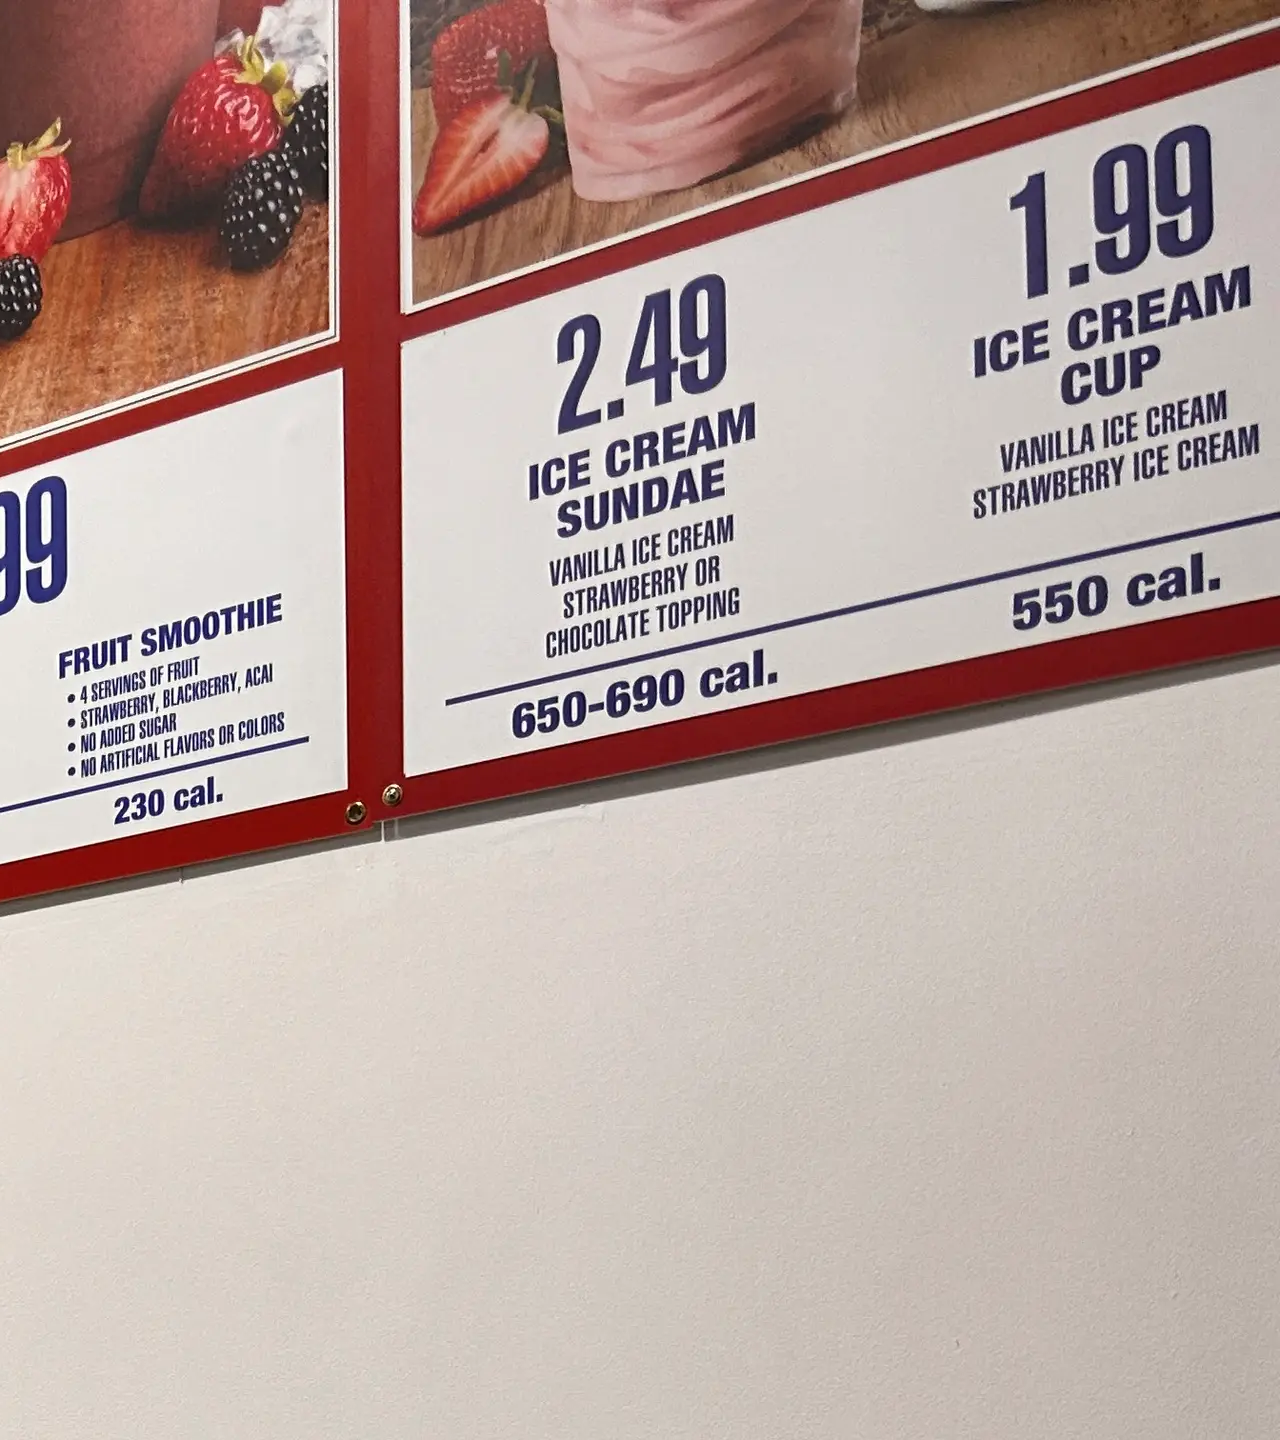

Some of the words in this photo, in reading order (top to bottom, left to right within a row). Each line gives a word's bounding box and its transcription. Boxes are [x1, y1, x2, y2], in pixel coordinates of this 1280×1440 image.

[1008, 124, 1215, 300] 1.99
[556, 273, 729, 435] 2.49
[973, 321, 1048, 379] ICE
[1066, 265, 1252, 351] CREAM
[1061, 346, 1161, 407] CUP
[528, 453, 590, 502] ICE
[605, 402, 757, 483] CREAM
[1000, 426, 1095, 474] VANILLA
[1103, 412, 1139, 454] ICE
[1144, 389, 1228, 446] CREAM
[556, 460, 726, 539] SUNDAE
[973, 455, 1125, 521] STRAWBERRY
[1132, 443, 1169, 482] ICE
[1175, 425, 1260, 475] CREAM
[549, 541, 625, 588] VANILLA
[631, 534, 661, 572] ICE
[666, 514, 734, 565] CREAM
[563, 567, 688, 620] STRAWBERRY
[695, 556, 720, 592] OR
[545, 611, 649, 661] CHOCOLATE
[656, 586, 741, 638] TOPPING
[1012, 574, 1108, 633] 550
[1127, 553, 1222, 611] cal.
[58, 635, 132, 679] FRUIT
[140, 592, 283, 657] SMOOTHIE
[80, 684, 87, 703] 4
[91, 672, 146, 702] SERVINGS
[150, 668, 163, 690] OF
[167, 657, 199, 687] FRUIT
[80, 695, 157, 730] STRAWBERRY,
[162, 673, 242, 713] BLACKBERRY,
[246, 664, 273, 691] ACAI
[512, 666, 685, 741] 650-690
[699, 648, 778, 702] cal.
[81, 732, 94, 753] NO
[99, 723, 135, 750] ADDED
[139, 713, 176, 743] SUGAR
[81, 756, 94, 778] NO
[99, 742, 161, 776] ARTIFICIAL
[164, 731, 214, 764] FLAVORS
[219, 726, 233, 750] OR
[238, 713, 284, 749] COLORS
[114, 794, 164, 825] 230
[173, 777, 223, 814] cal.
